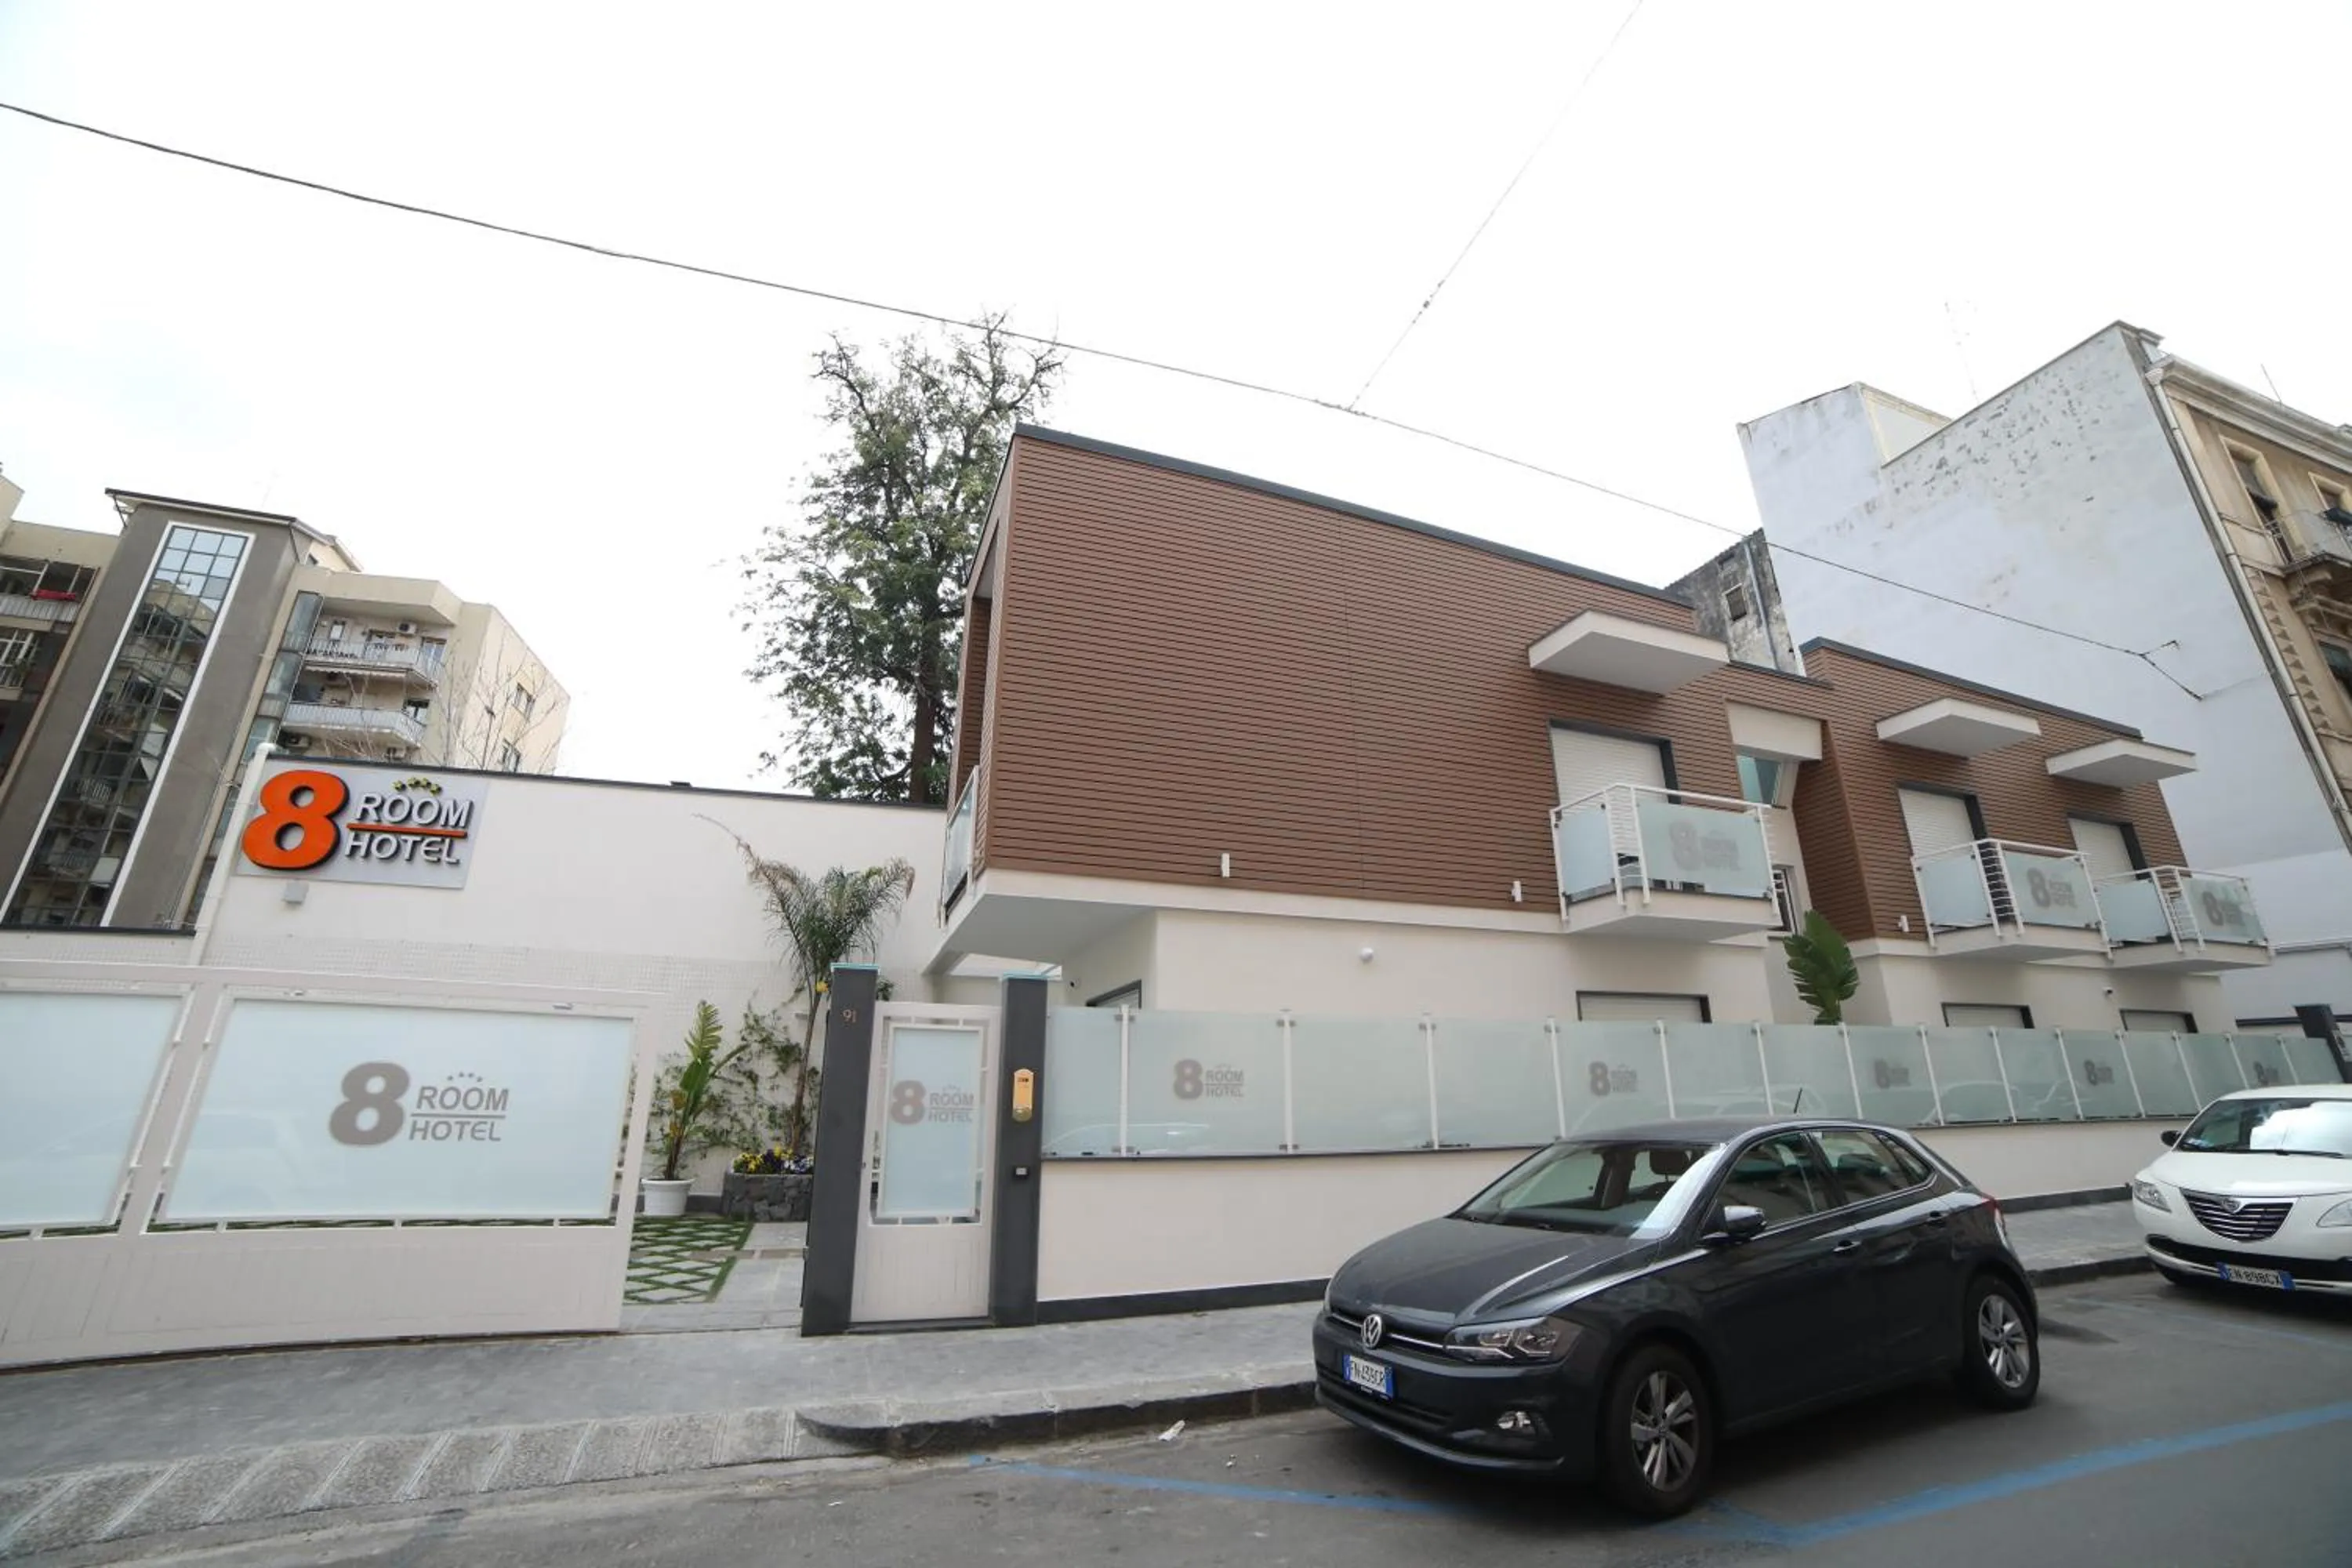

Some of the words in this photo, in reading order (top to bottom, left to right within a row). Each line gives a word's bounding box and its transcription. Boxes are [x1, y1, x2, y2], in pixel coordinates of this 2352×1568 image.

[241, 769, 349, 869] 8
[355, 791, 474, 828] ROOM
[345, 831, 460, 864] HOTEL
[1173, 1058, 1203, 1099] 8
[1205, 1069, 1244, 1082] ROOM
[1588, 1061, 1610, 1096] 8
[328, 1062, 410, 1146] 8
[416, 1086, 509, 1111] ROOM
[891, 1080, 926, 1125] 8
[929, 1092, 975, 1106] ROOM
[408, 1120, 501, 1142] HOTEL
[927, 1112, 973, 1123] HOTEL
